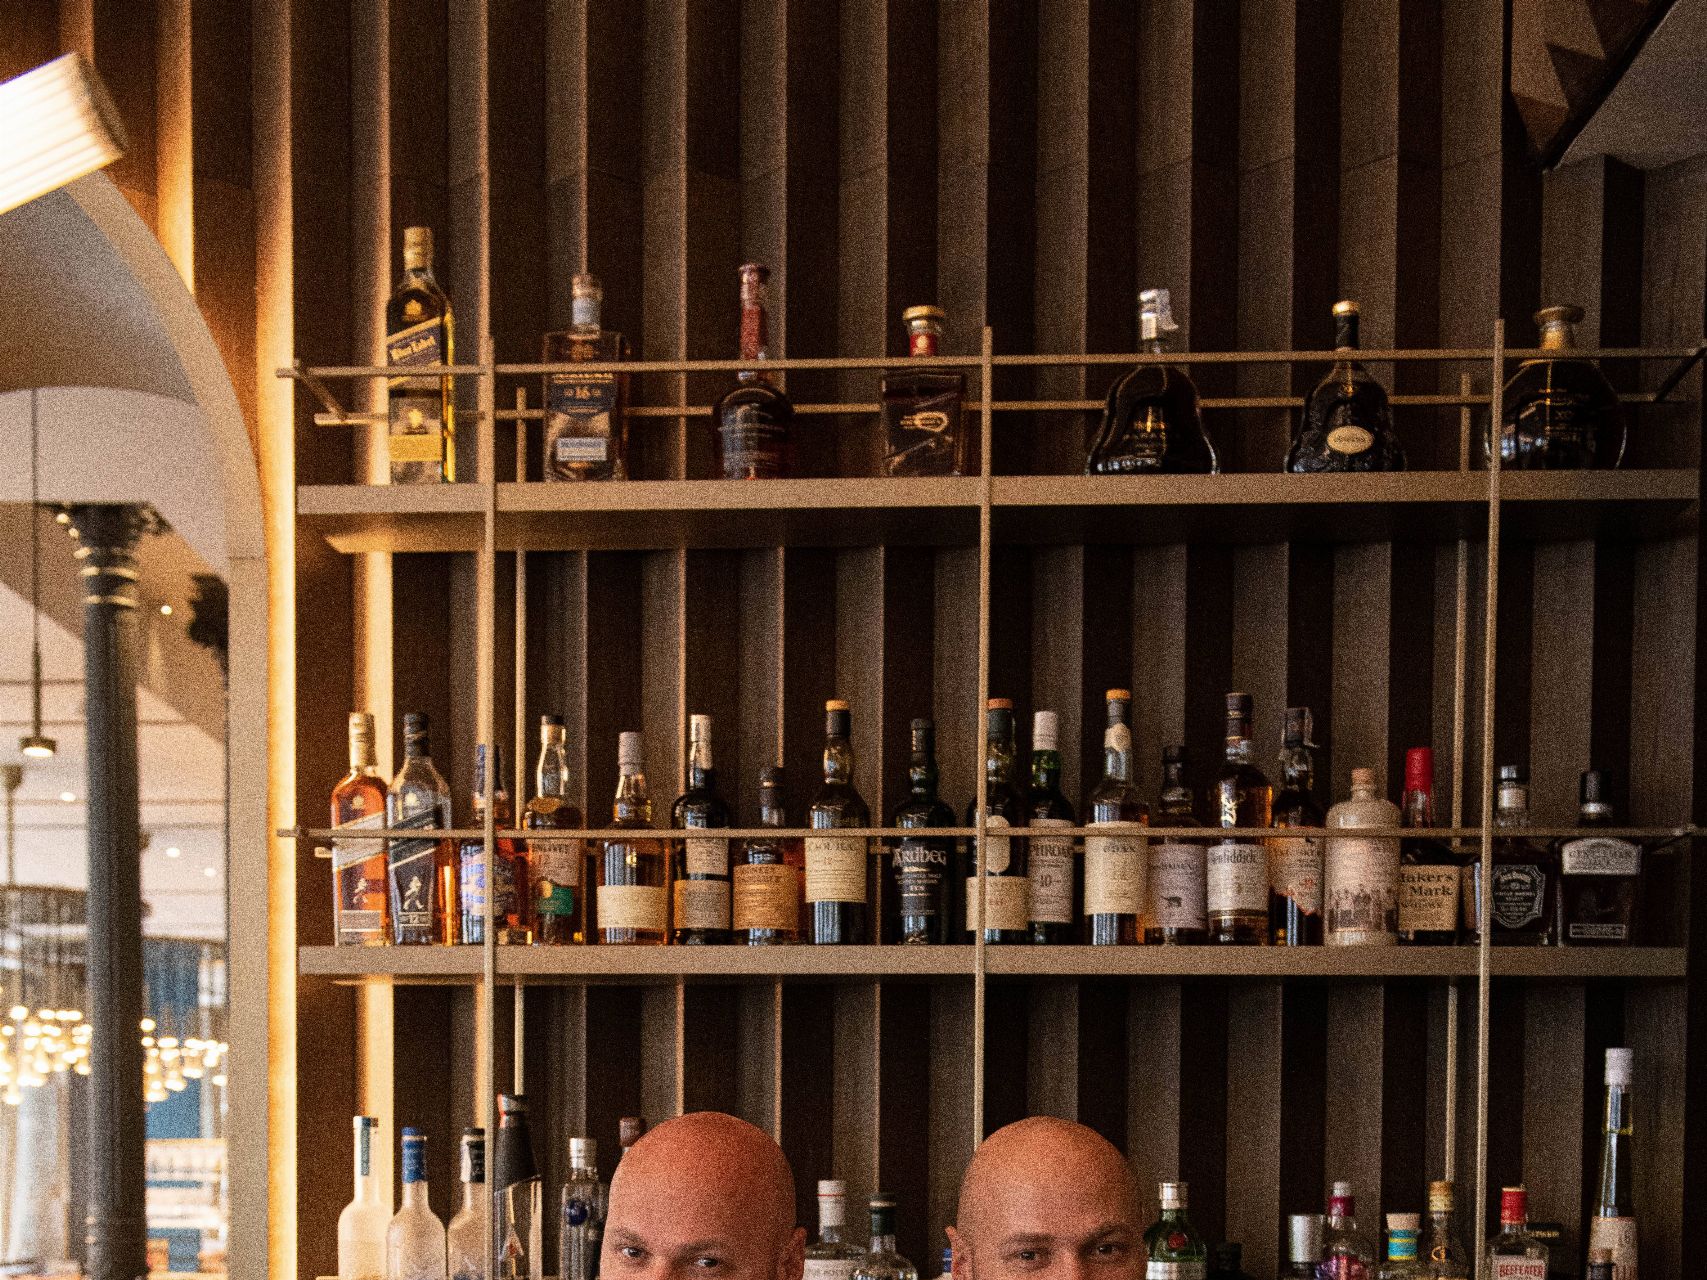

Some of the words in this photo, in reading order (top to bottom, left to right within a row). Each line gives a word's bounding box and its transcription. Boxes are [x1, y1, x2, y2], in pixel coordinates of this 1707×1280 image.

[1040, 874, 1053, 888] 10
[1410, 884, 1453, 897] Mark
[1498, 1264, 1544, 1279] BEEFEATER
